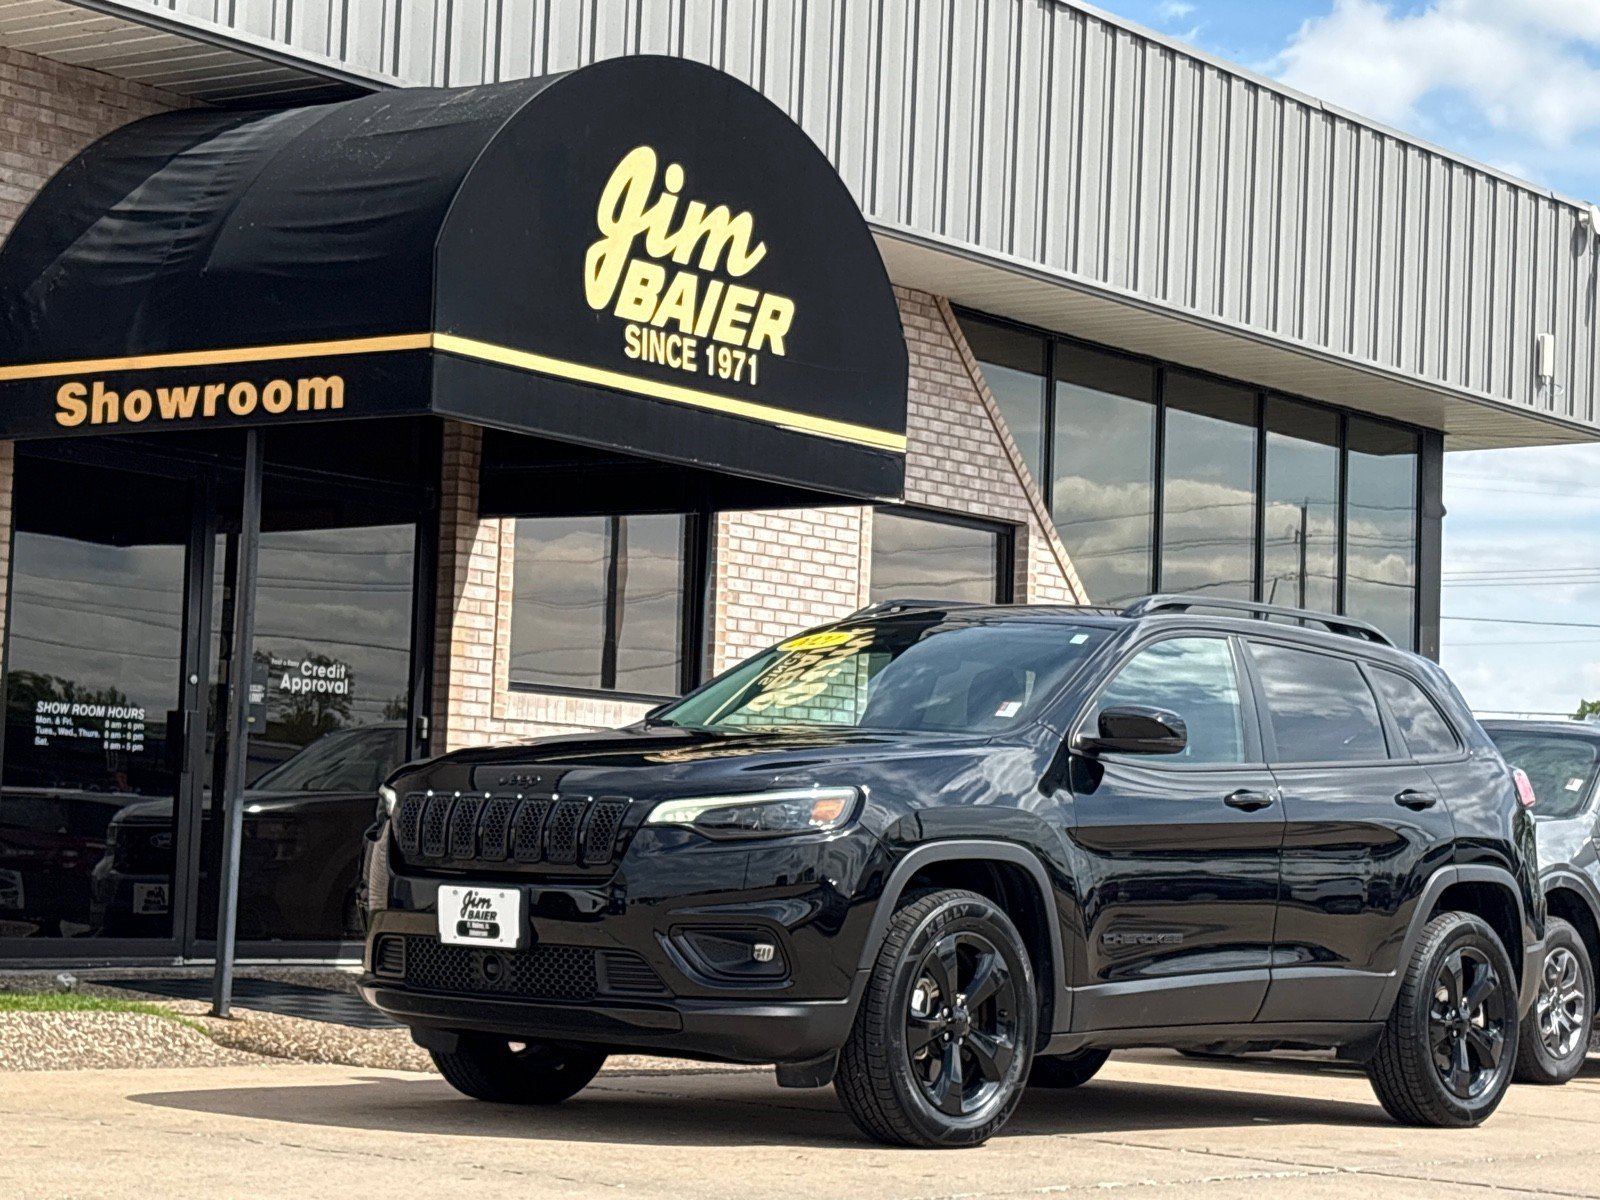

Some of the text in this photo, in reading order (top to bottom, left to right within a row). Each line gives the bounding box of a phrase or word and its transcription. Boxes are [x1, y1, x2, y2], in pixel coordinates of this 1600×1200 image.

[584, 145, 767, 310] Jim
[614, 258, 795, 356] BAIER
[624, 324, 758, 386] SINCE 1971
[55, 375, 345, 427] Showroom
[301, 661, 346, 679] Credit
[280, 672, 349, 695] Approval
[36, 700, 145, 720] SHOW ROOM HOURS
[110, 732, 122, 740] am
[132, 733, 144, 742] pm
[111, 721, 122, 729] am
[133, 723, 145, 732] pm
[110, 742, 121, 750] am
[132, 744, 144, 753] pm
[460, 890, 492, 919] Jim
[467, 909, 498, 921] BAIER
[926, 904, 969, 939] KELLY
[1102, 932, 1184, 944] CHEROKEE
